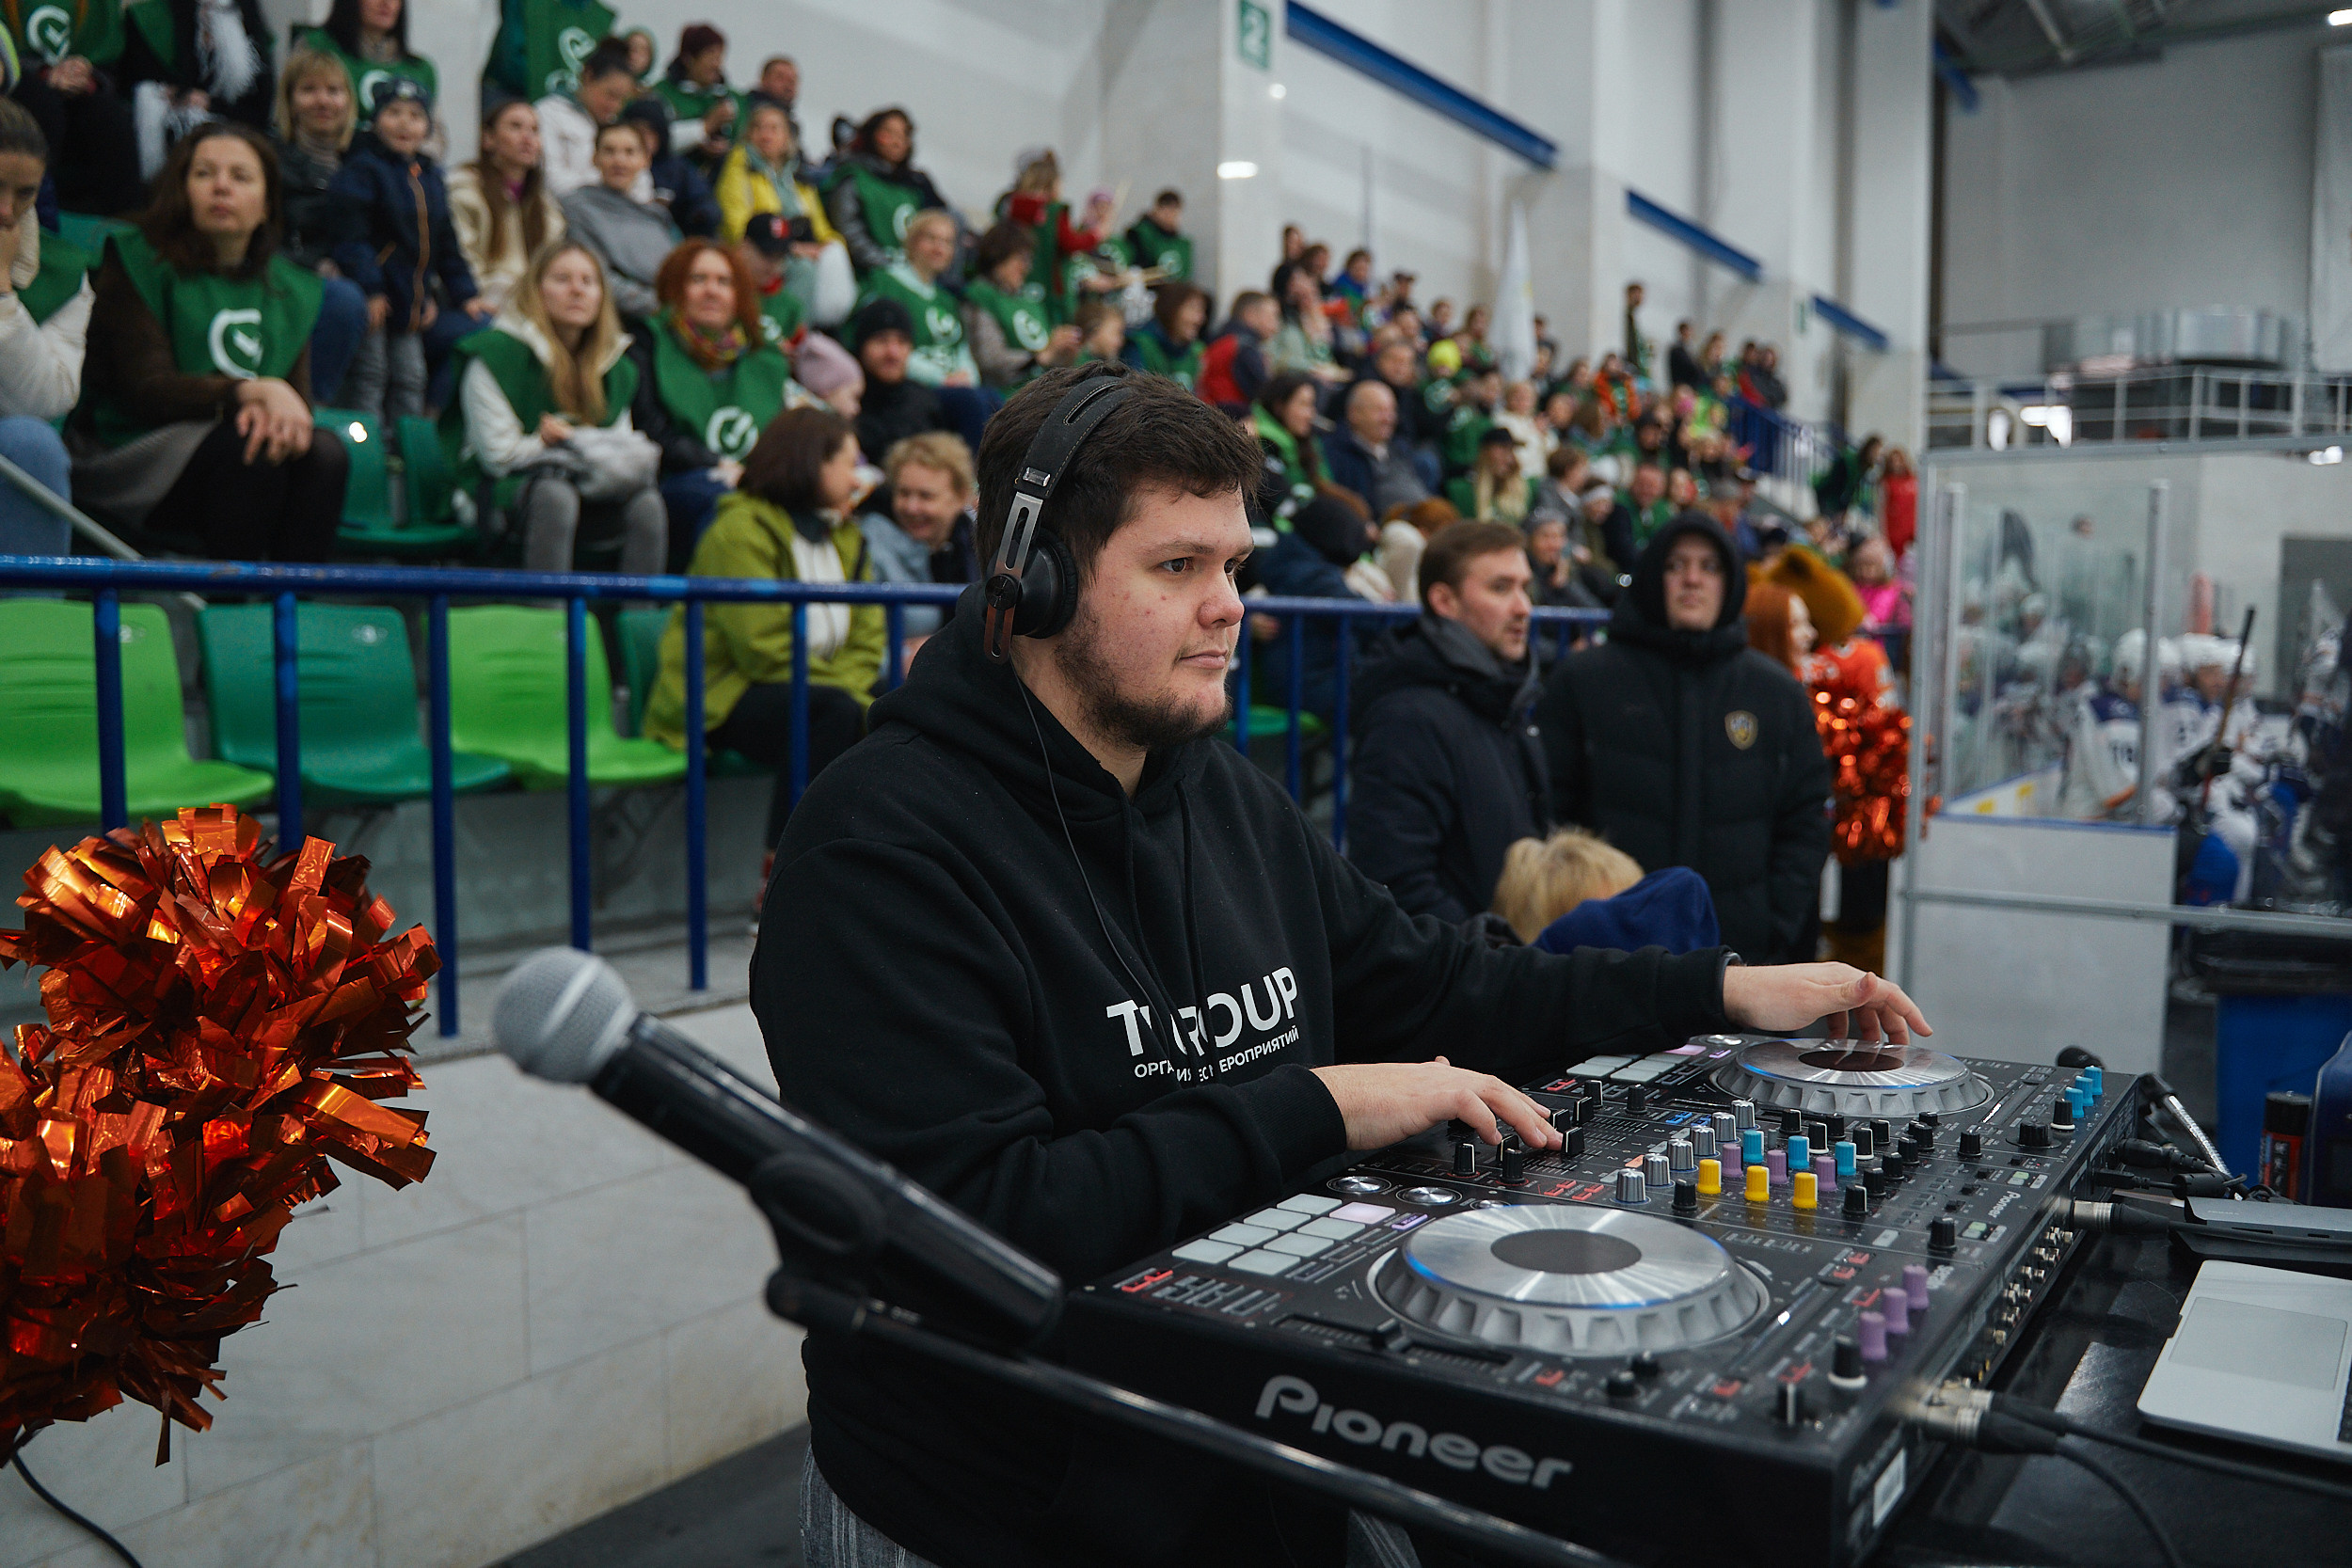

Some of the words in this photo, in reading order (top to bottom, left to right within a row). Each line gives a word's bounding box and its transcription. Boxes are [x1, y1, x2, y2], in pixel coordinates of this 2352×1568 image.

[1209, 1024, 1299, 1077] ЕРОПРИЯТИЙ
[1987, 1190, 2022, 1218] Pioneer
[1254, 1374, 1574, 1490] Pioneer
